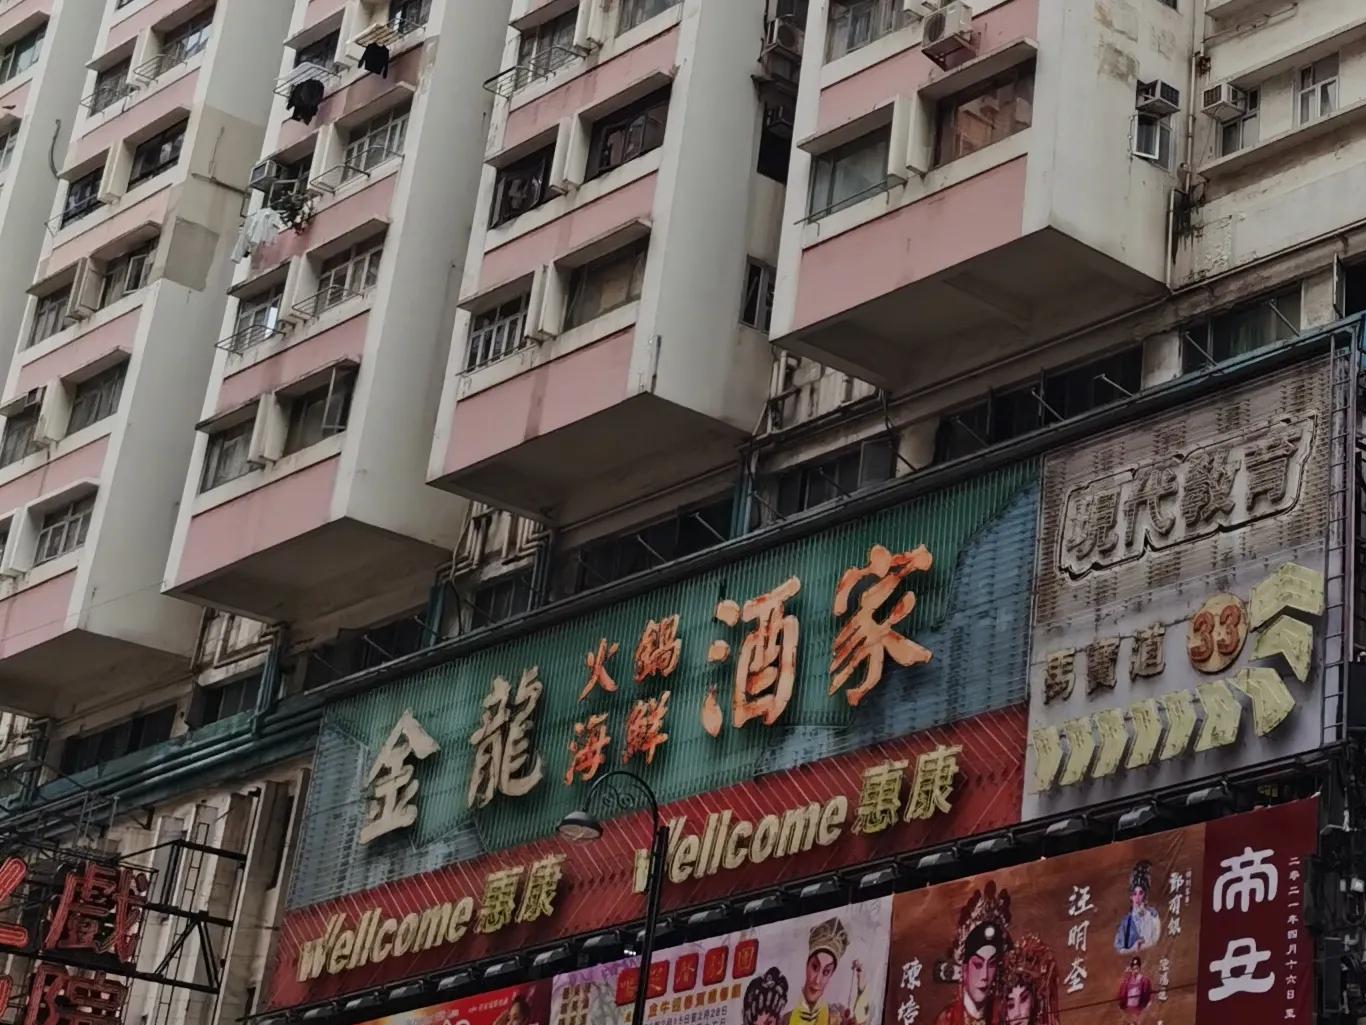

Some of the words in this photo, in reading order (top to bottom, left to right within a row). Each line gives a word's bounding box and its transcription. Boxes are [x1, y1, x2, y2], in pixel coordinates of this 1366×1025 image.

[1066, 432, 1303, 558] 現代教育
[578, 614, 682, 702] 火鍋
[701, 543, 935, 736] 酒家
[1044, 622, 1167, 705] 馬寶道
[1189, 603, 1243, 664] 33
[359, 665, 546, 845] 金龍
[563, 692, 671, 786] 海鮮
[632, 795, 850, 894] Wellcome
[851, 744, 963, 835] 惠康
[297, 893, 474, 983] Wellcome
[474, 853, 567, 936] 惠康
[1063, 885, 1097, 994] 汪明荃
